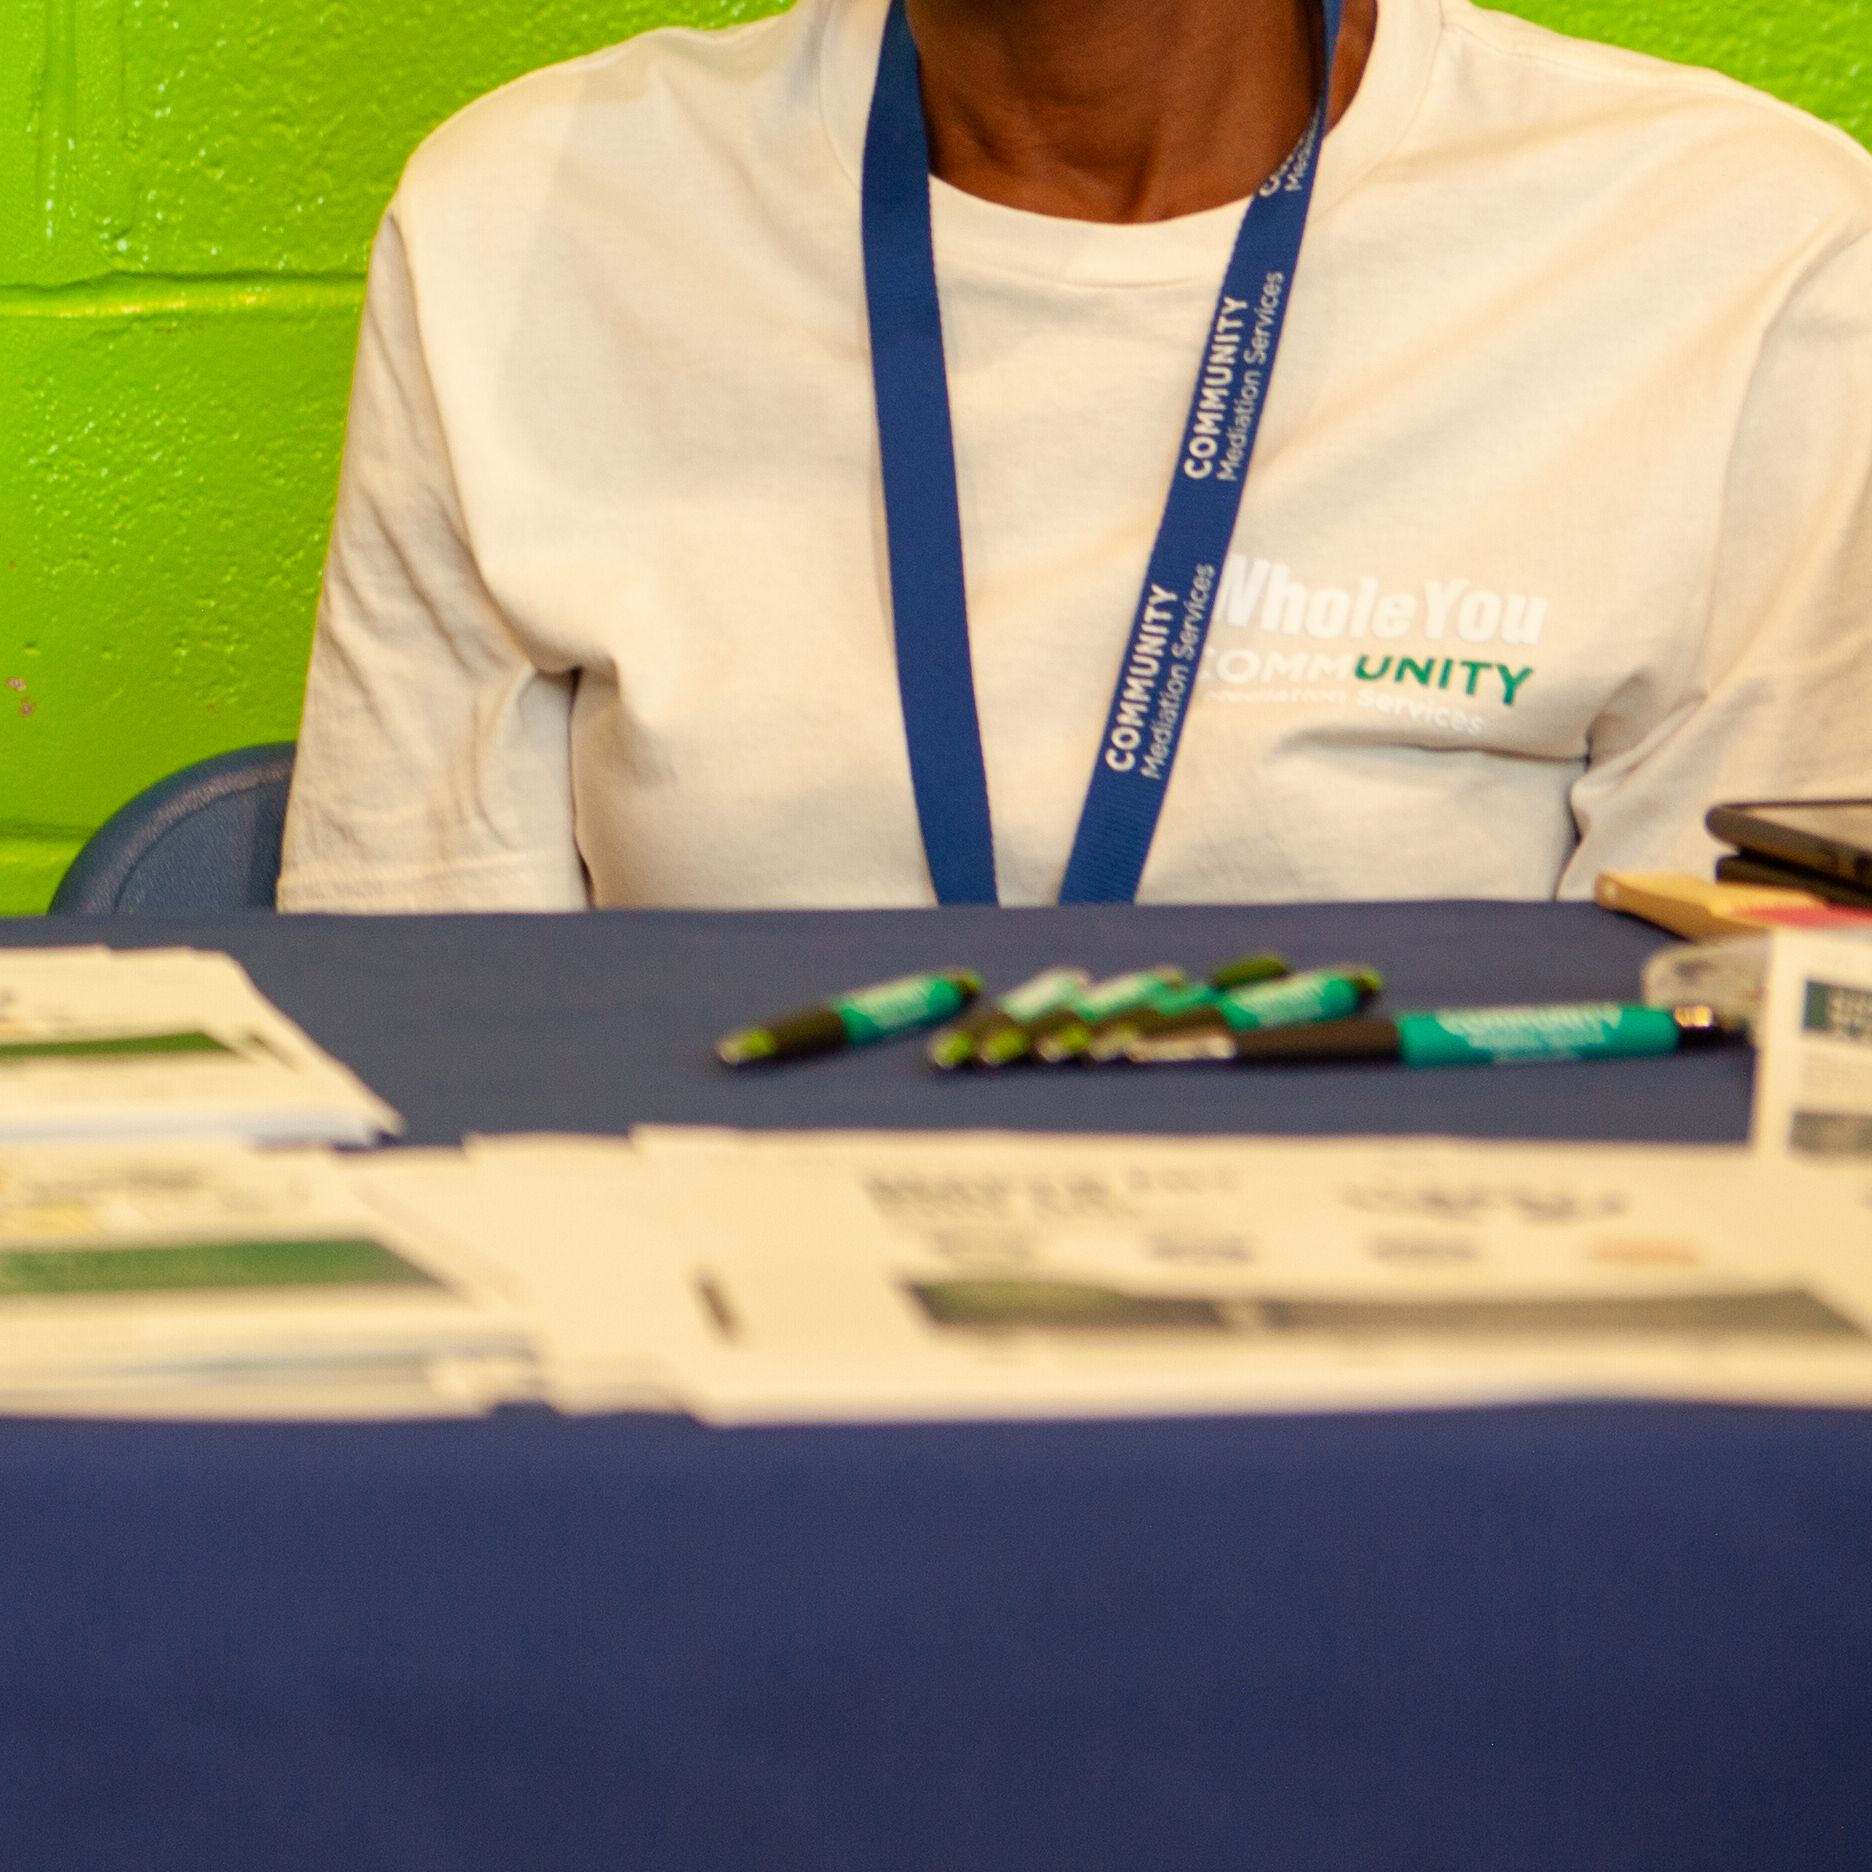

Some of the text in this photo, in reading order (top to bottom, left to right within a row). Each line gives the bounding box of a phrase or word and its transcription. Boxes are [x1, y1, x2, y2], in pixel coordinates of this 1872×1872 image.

[1184, 296, 1248, 480] COMMUNITY
[1217, 271, 1284, 482] Mediation Services
[1105, 583, 1178, 773] COMMUNITY
[1140, 562, 1215, 780] Mediation Services
[1203, 647, 1534, 707] OMMUNITY
[1356, 688, 1484, 736] Services
